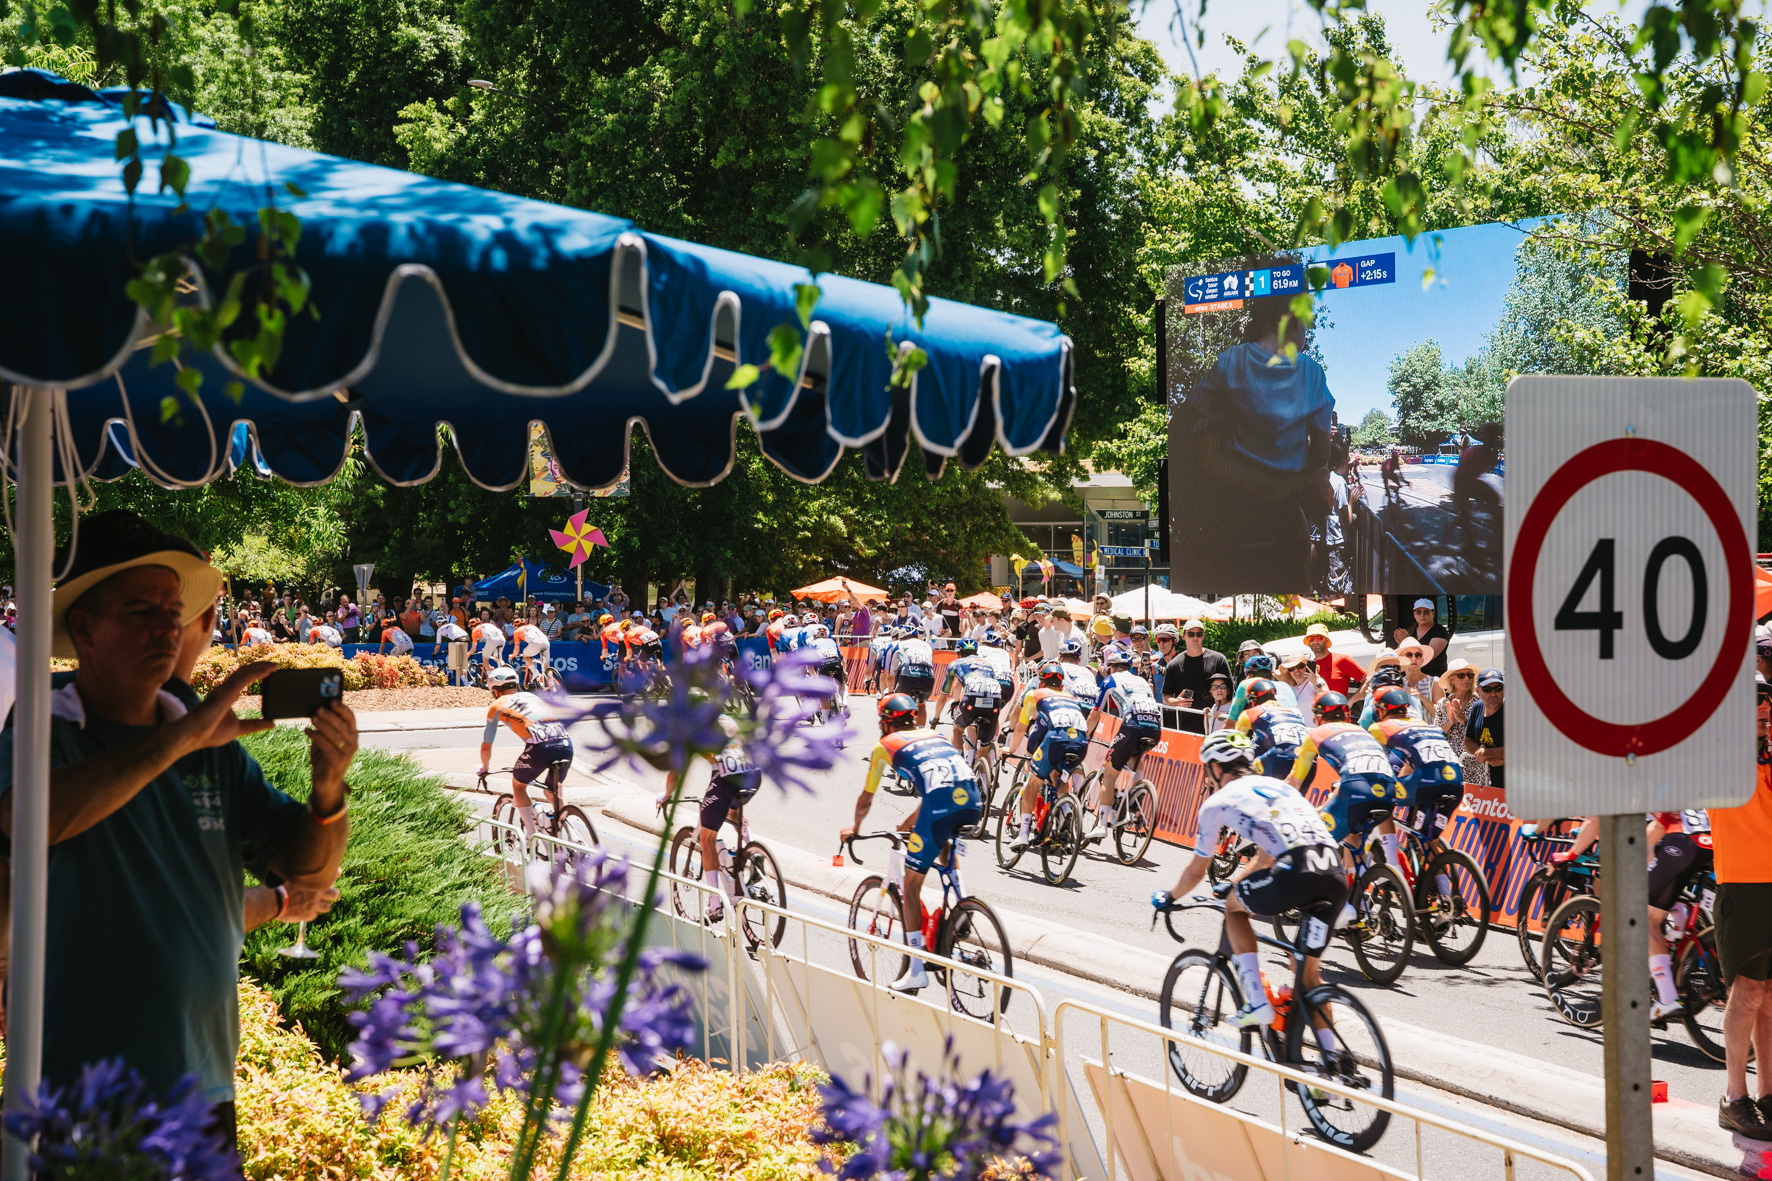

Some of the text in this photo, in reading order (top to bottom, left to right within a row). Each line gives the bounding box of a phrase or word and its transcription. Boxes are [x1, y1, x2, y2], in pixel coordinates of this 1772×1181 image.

[1281, 269, 1291, 277] GO
[1258, 276, 1265, 289] 1
[1272, 278, 1289, 290] 61.9
[1210, 302, 1229, 310] STAGE
[1104, 510, 1133, 519] JOHNSTON
[1103, 547, 1142, 556] MEDICAL CLINIC
[1554, 536, 1708, 660] 40
[1137, 714, 1158, 723] BORA
